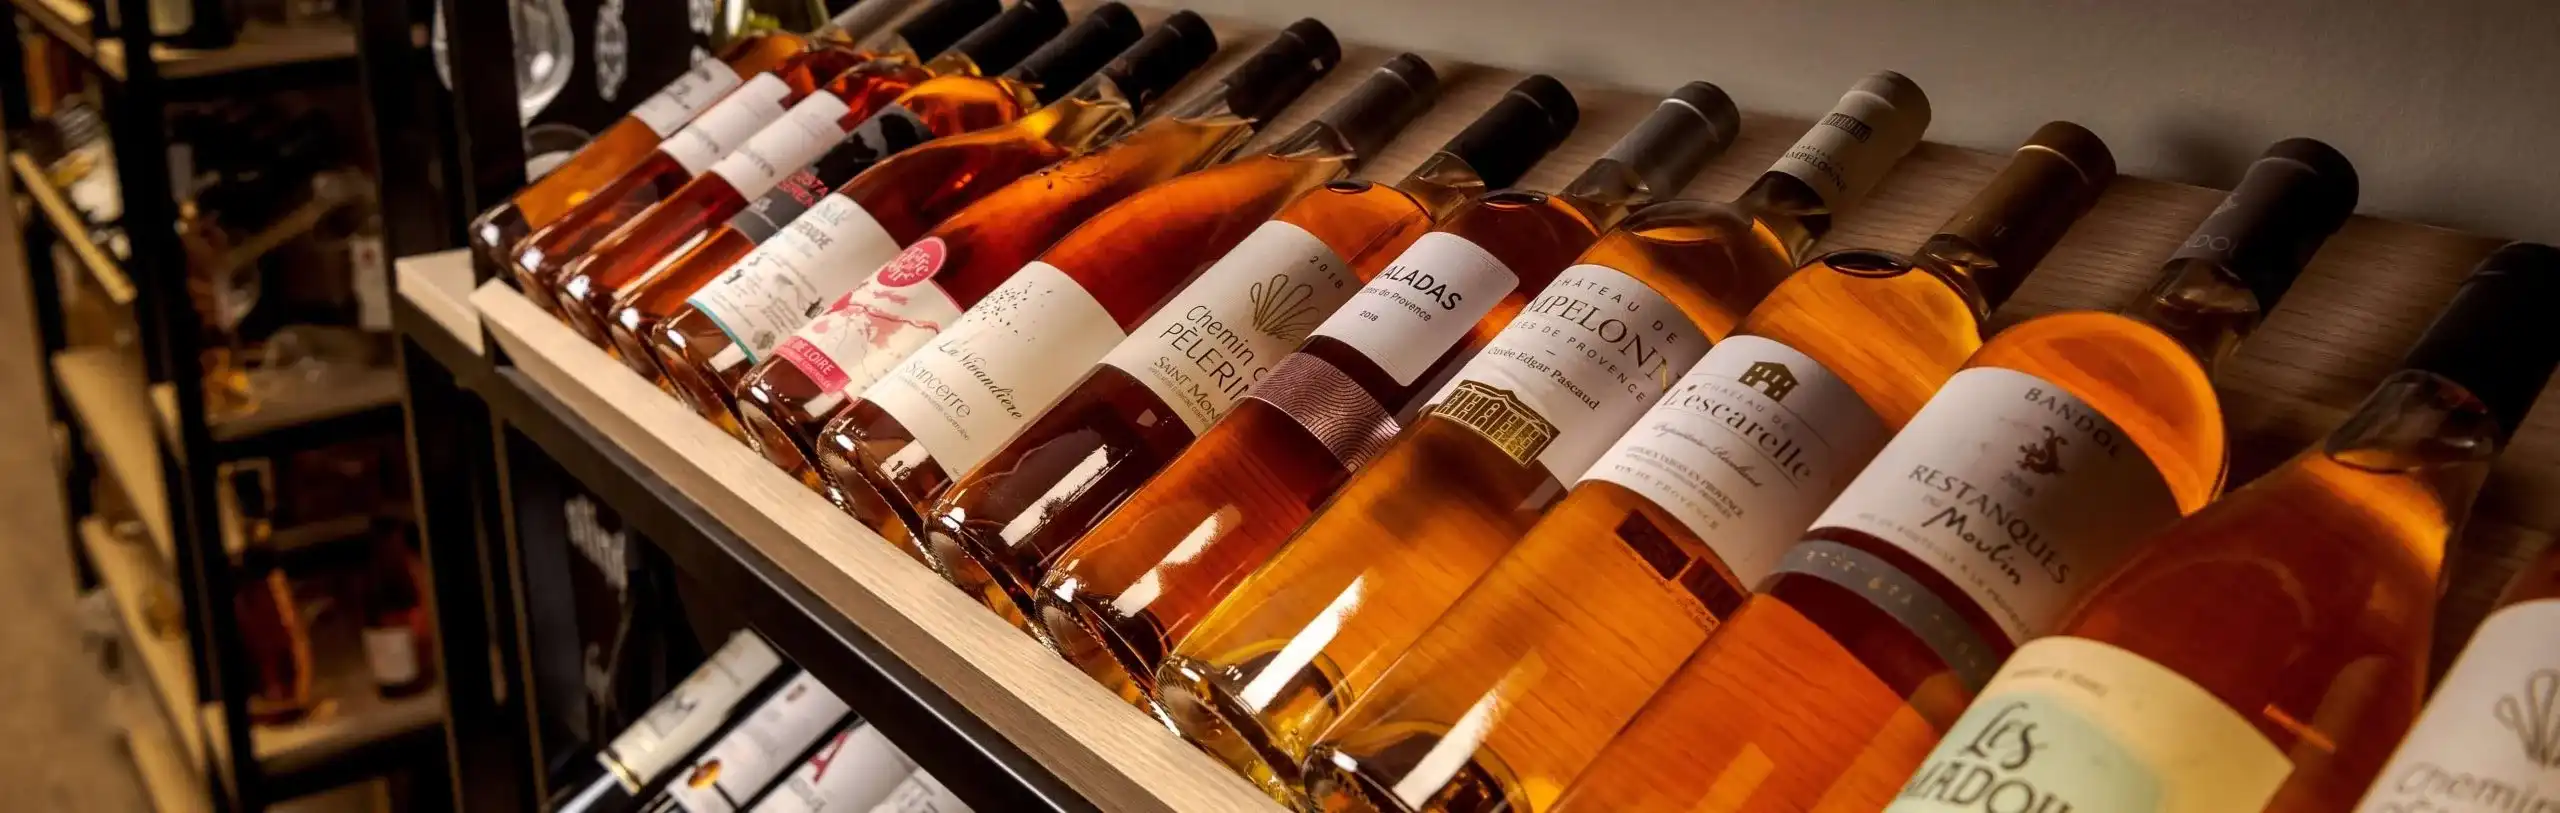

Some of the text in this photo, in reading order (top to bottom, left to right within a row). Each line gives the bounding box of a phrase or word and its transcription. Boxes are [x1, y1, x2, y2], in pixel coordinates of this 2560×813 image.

[1309, 254, 1345, 290] 2018
[1383, 264, 1462, 311] ALADAS
[1185, 303, 1255, 368] Chemin
[1359, 309, 1379, 322] 2018
[1378, 287, 1391, 298] de
[1390, 291, 1432, 323] Provence
[1651, 319, 1678, 345] DE
[803, 347, 836, 377] LOIRE
[1523, 295, 1682, 395] MPELONN
[1541, 327, 1560, 338] DE
[1565, 335, 1648, 403] PROVENCE
[903, 359, 972, 420] Sancerre
[937, 338, 960, 359] La
[957, 350, 1024, 421] Vivandière
[1187, 383, 1221, 422] MON
[1516, 351, 1551, 374] Edgar
[1550, 368, 1601, 412] Pascaud
[2023, 386, 2123, 459] BANDOL
[1907, 463, 2072, 586] RESTANQUES
[1920, 505, 2023, 587] Moulin
